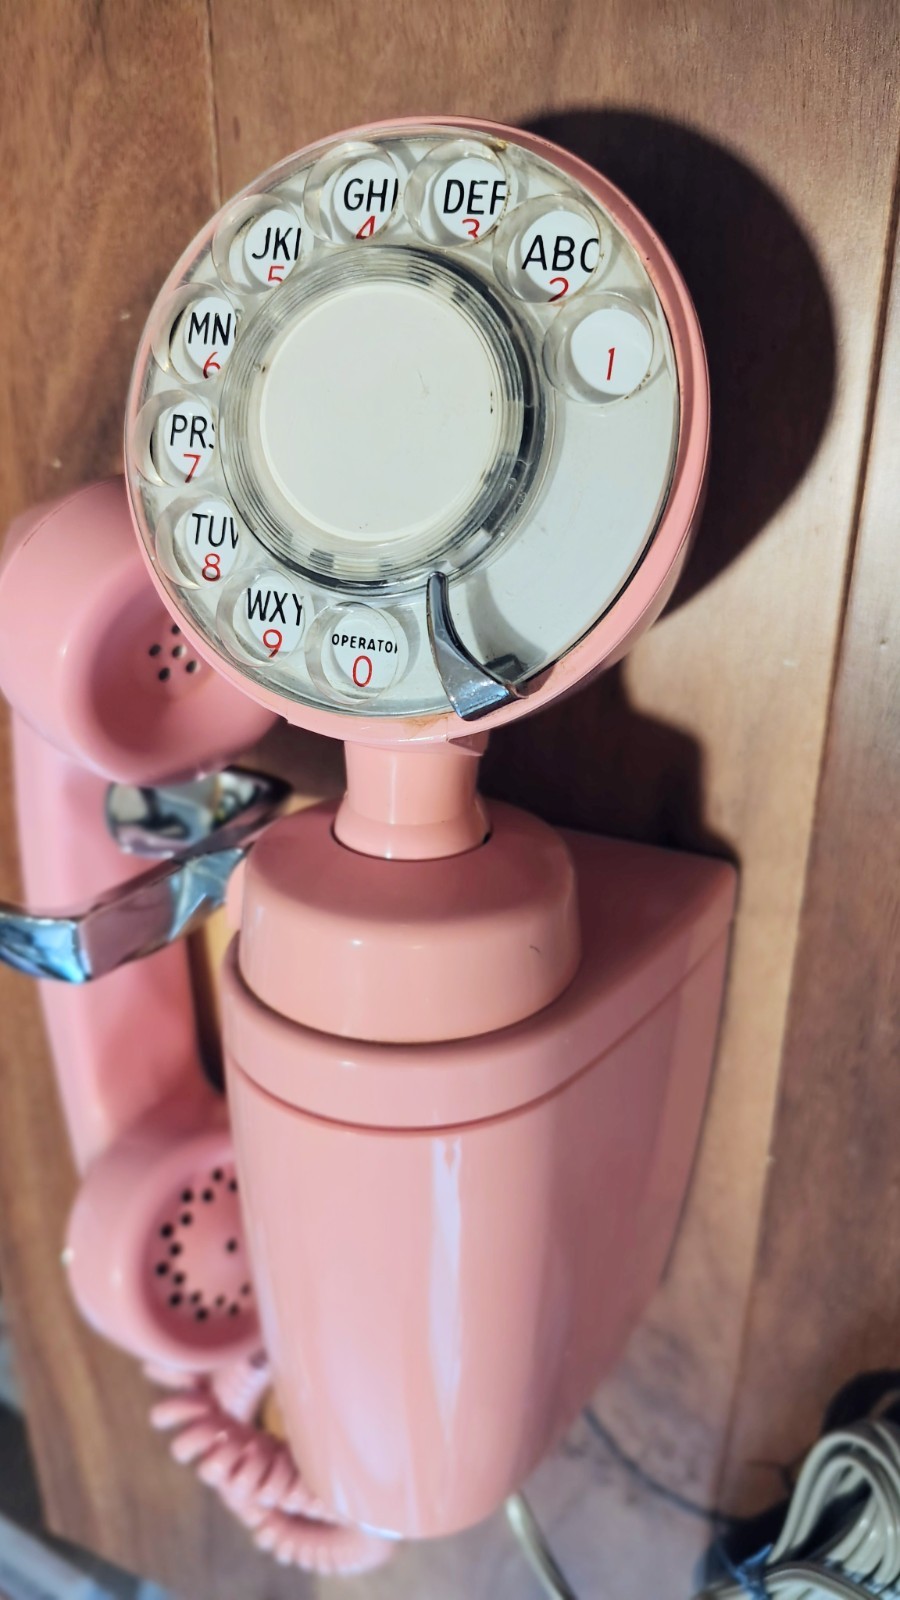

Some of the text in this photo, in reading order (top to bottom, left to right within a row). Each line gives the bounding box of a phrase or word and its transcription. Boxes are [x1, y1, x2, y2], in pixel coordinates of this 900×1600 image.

[267, 265, 285, 284] 5
[548, 277, 569, 302] 2
[188, 311, 237, 346] MN
[203, 351, 221, 379] 6
[606, 347, 616, 381] 1
[170, 414, 215, 449] PR
[183, 453, 201, 483] 7
[201, 553, 221, 582] 8
[262, 629, 283, 658] 9
[352, 655, 373, 688] 0
